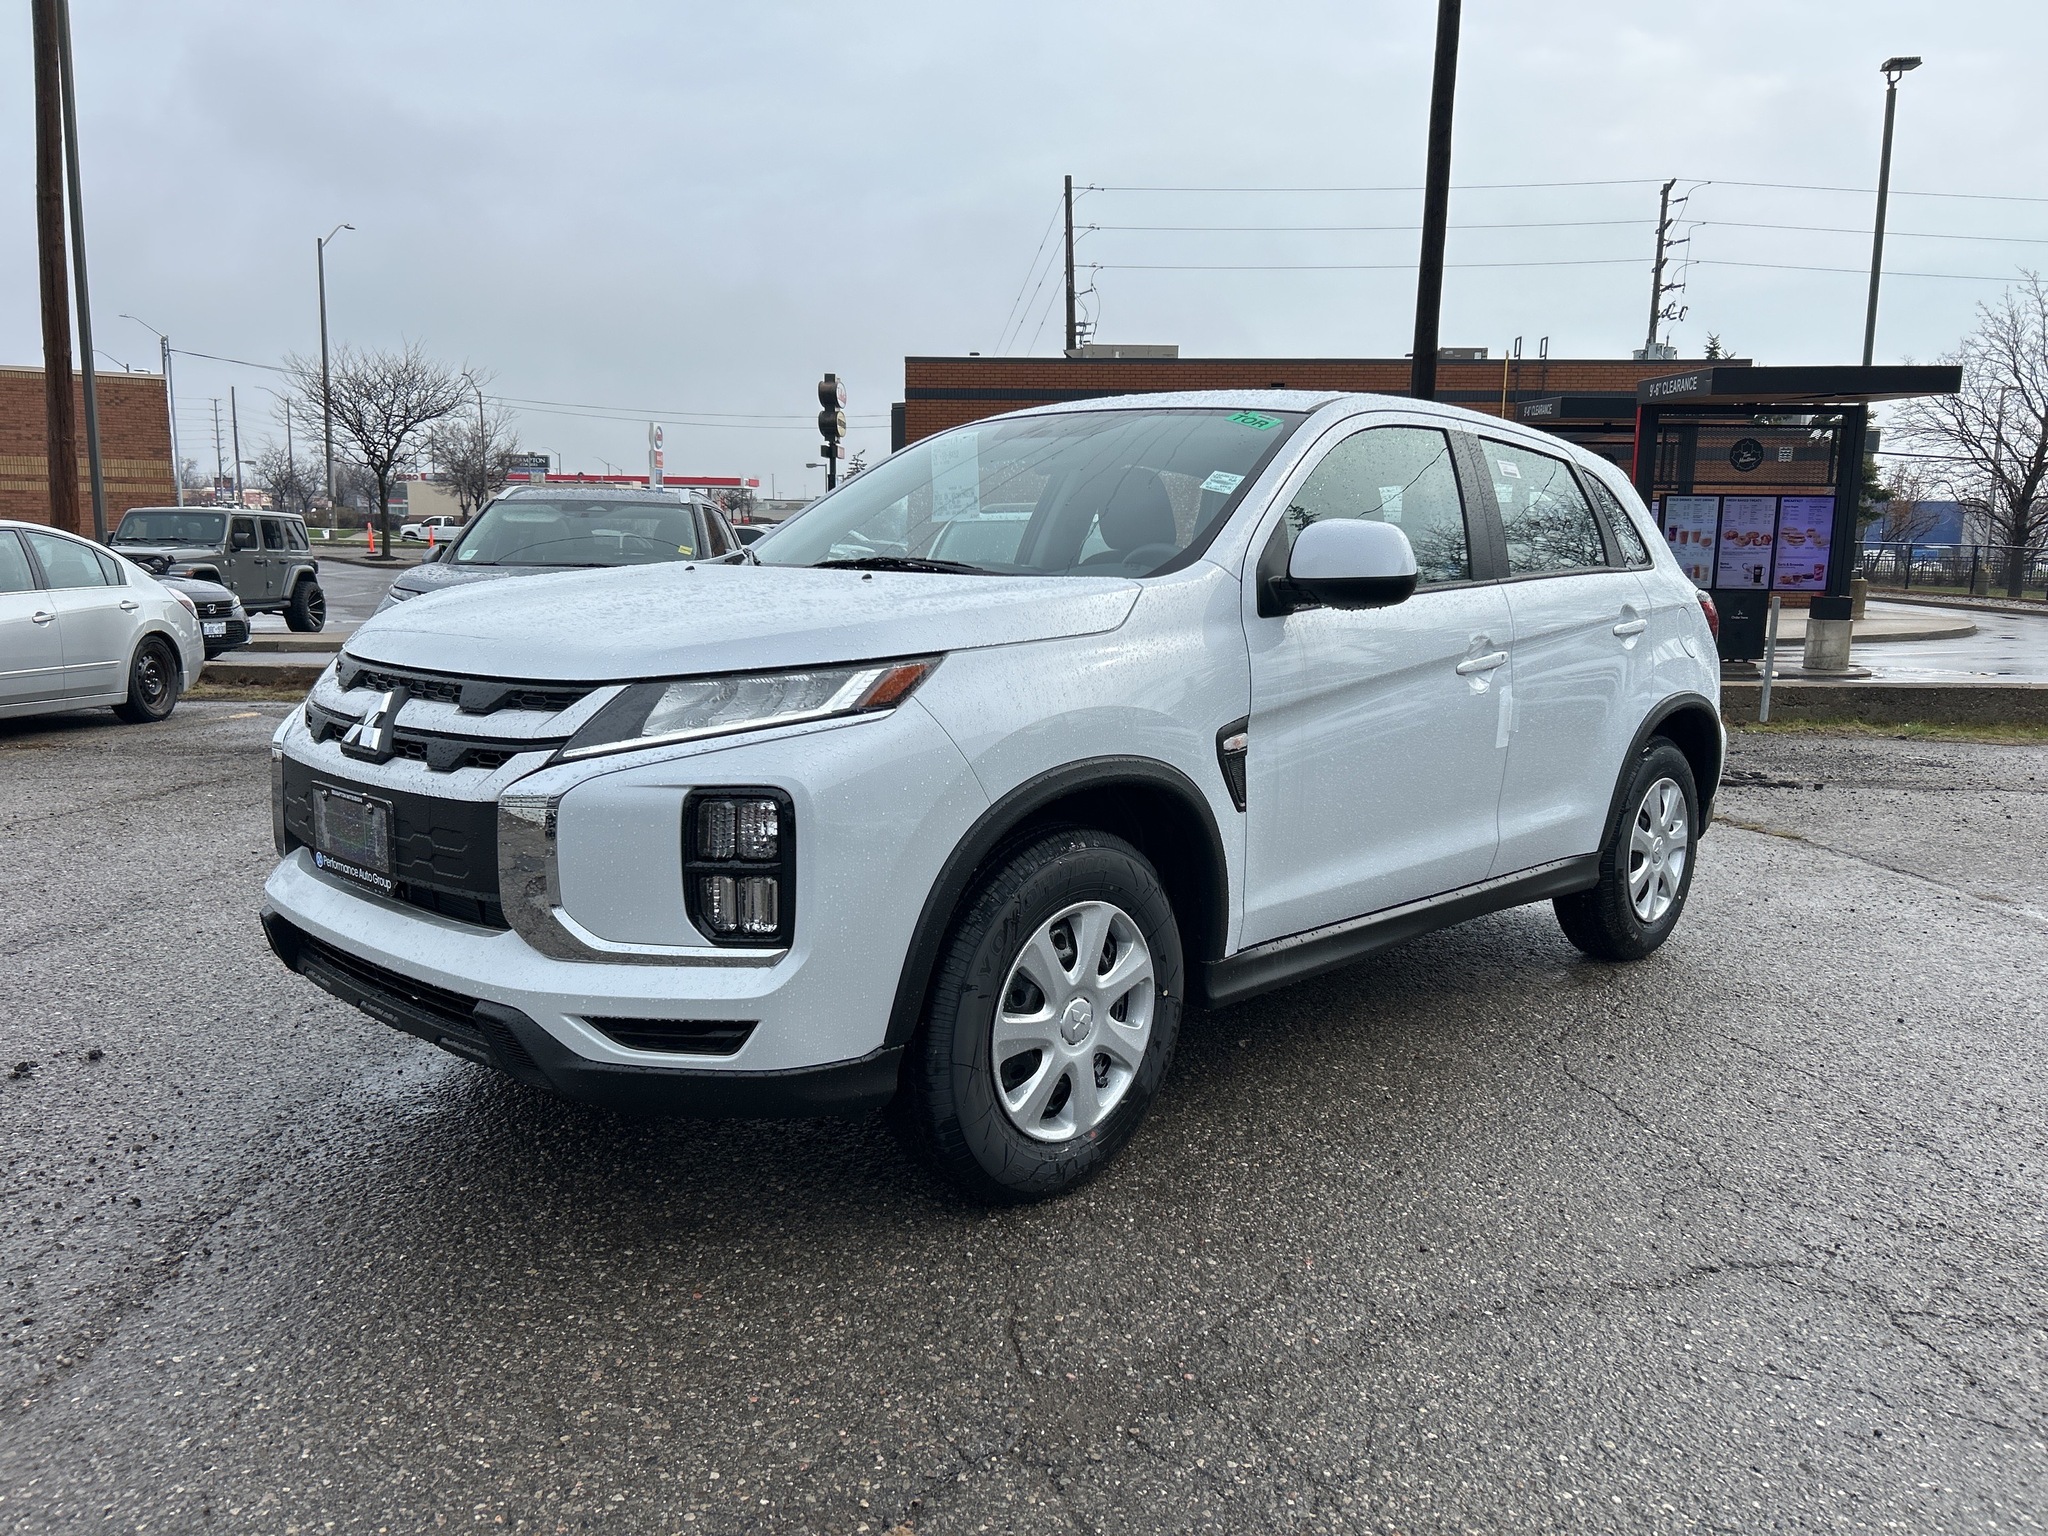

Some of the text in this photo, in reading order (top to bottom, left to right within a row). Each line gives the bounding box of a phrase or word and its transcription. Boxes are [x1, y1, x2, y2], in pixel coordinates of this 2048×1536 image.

[1661, 376, 1698, 395] CLEARANCE
[1233, 414, 1269, 428] TOR
[323, 855, 392, 892] Performance Auto Group
